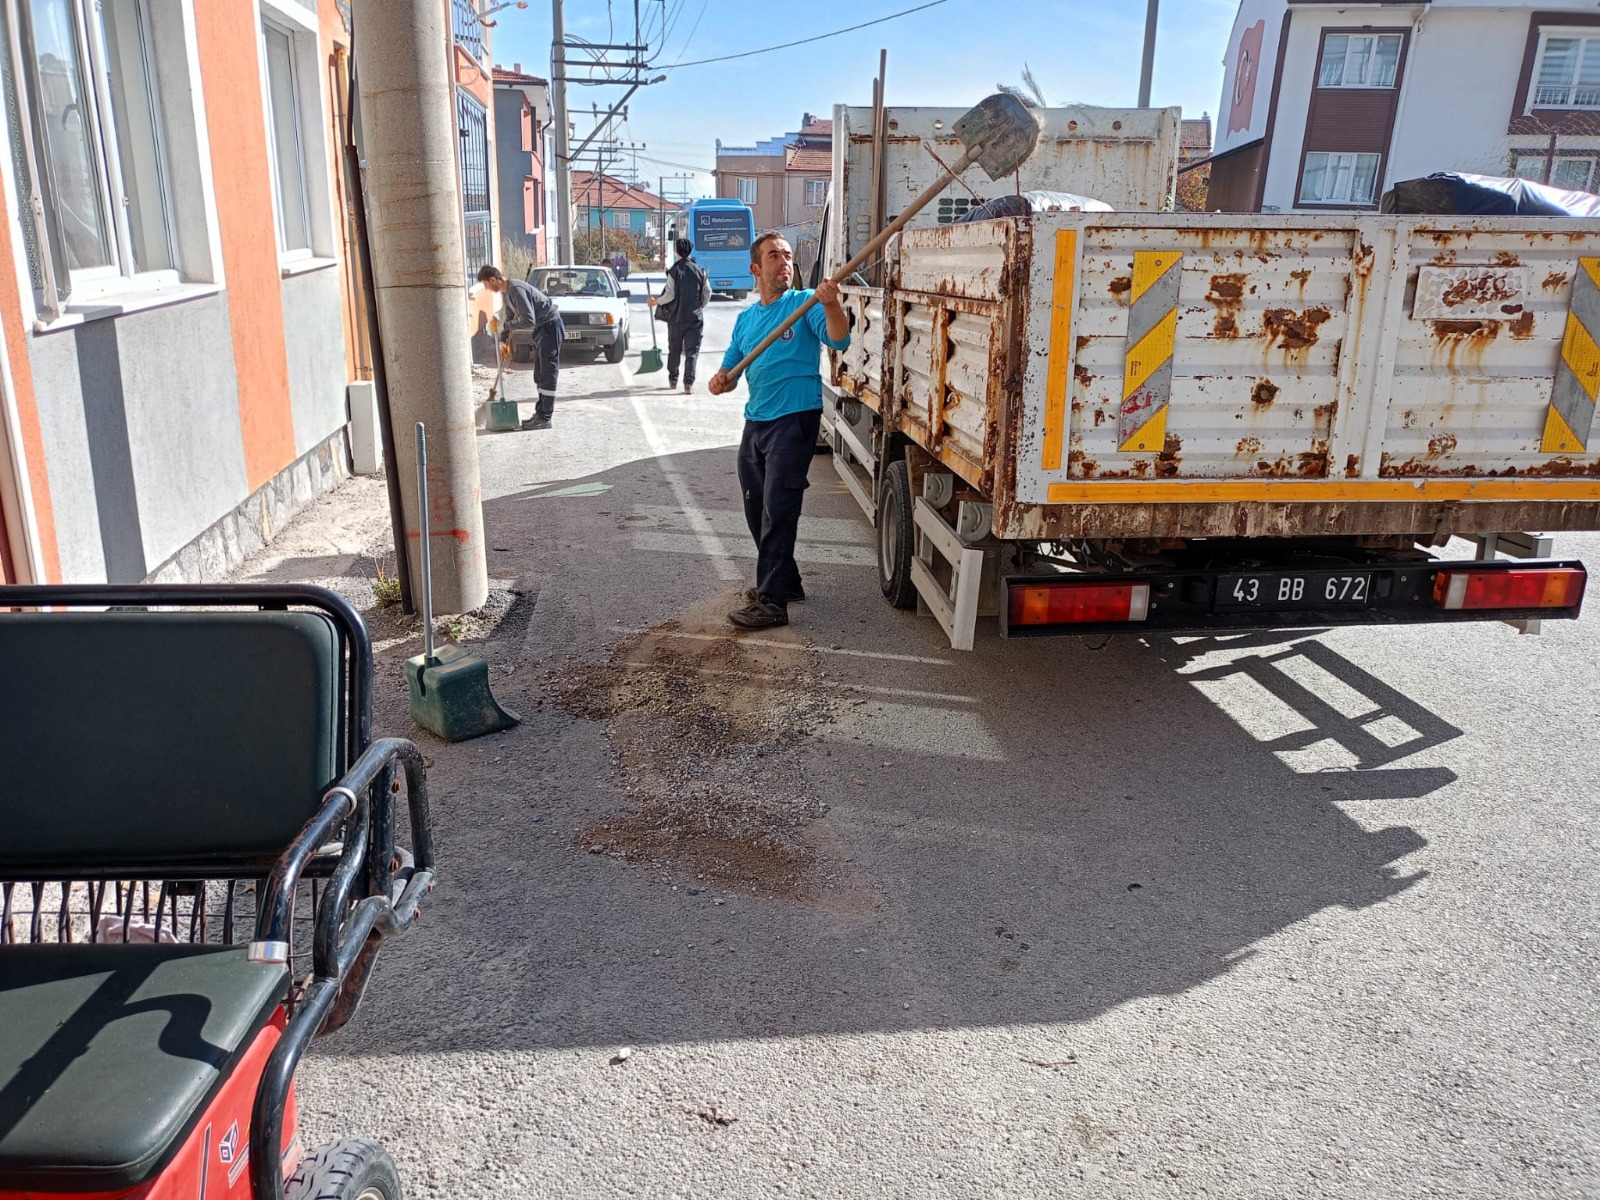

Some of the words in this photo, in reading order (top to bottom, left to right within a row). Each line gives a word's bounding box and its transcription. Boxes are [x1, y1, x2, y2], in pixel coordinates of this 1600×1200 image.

[1232, 578, 1259, 602] 43
[1277, 577, 1305, 601] BB
[1324, 577, 1366, 600] 672
